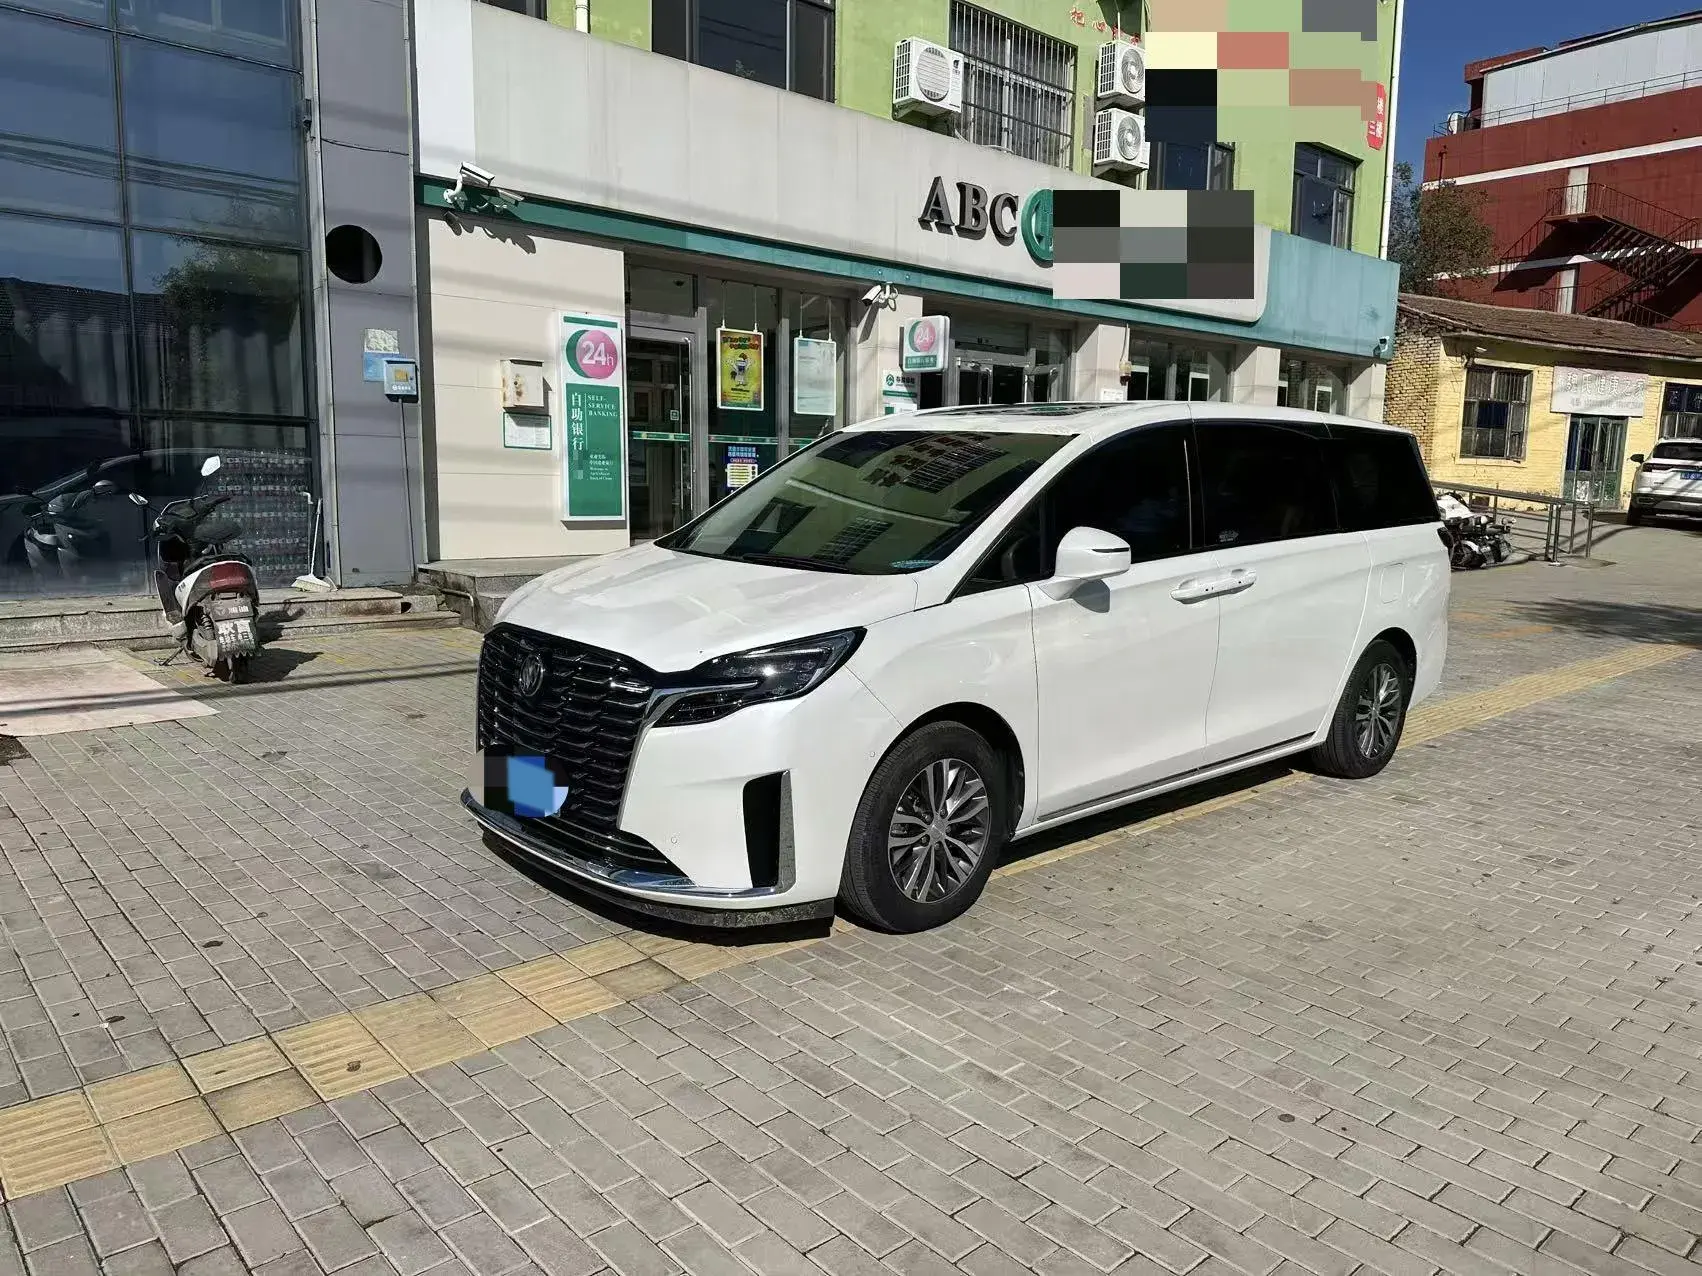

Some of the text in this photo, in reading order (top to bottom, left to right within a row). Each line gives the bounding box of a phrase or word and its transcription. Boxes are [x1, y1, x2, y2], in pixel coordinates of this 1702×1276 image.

[918, 176, 1019, 240] ABC
[582, 340, 614, 366] 24h
[571, 392, 584, 451] 自助银行
